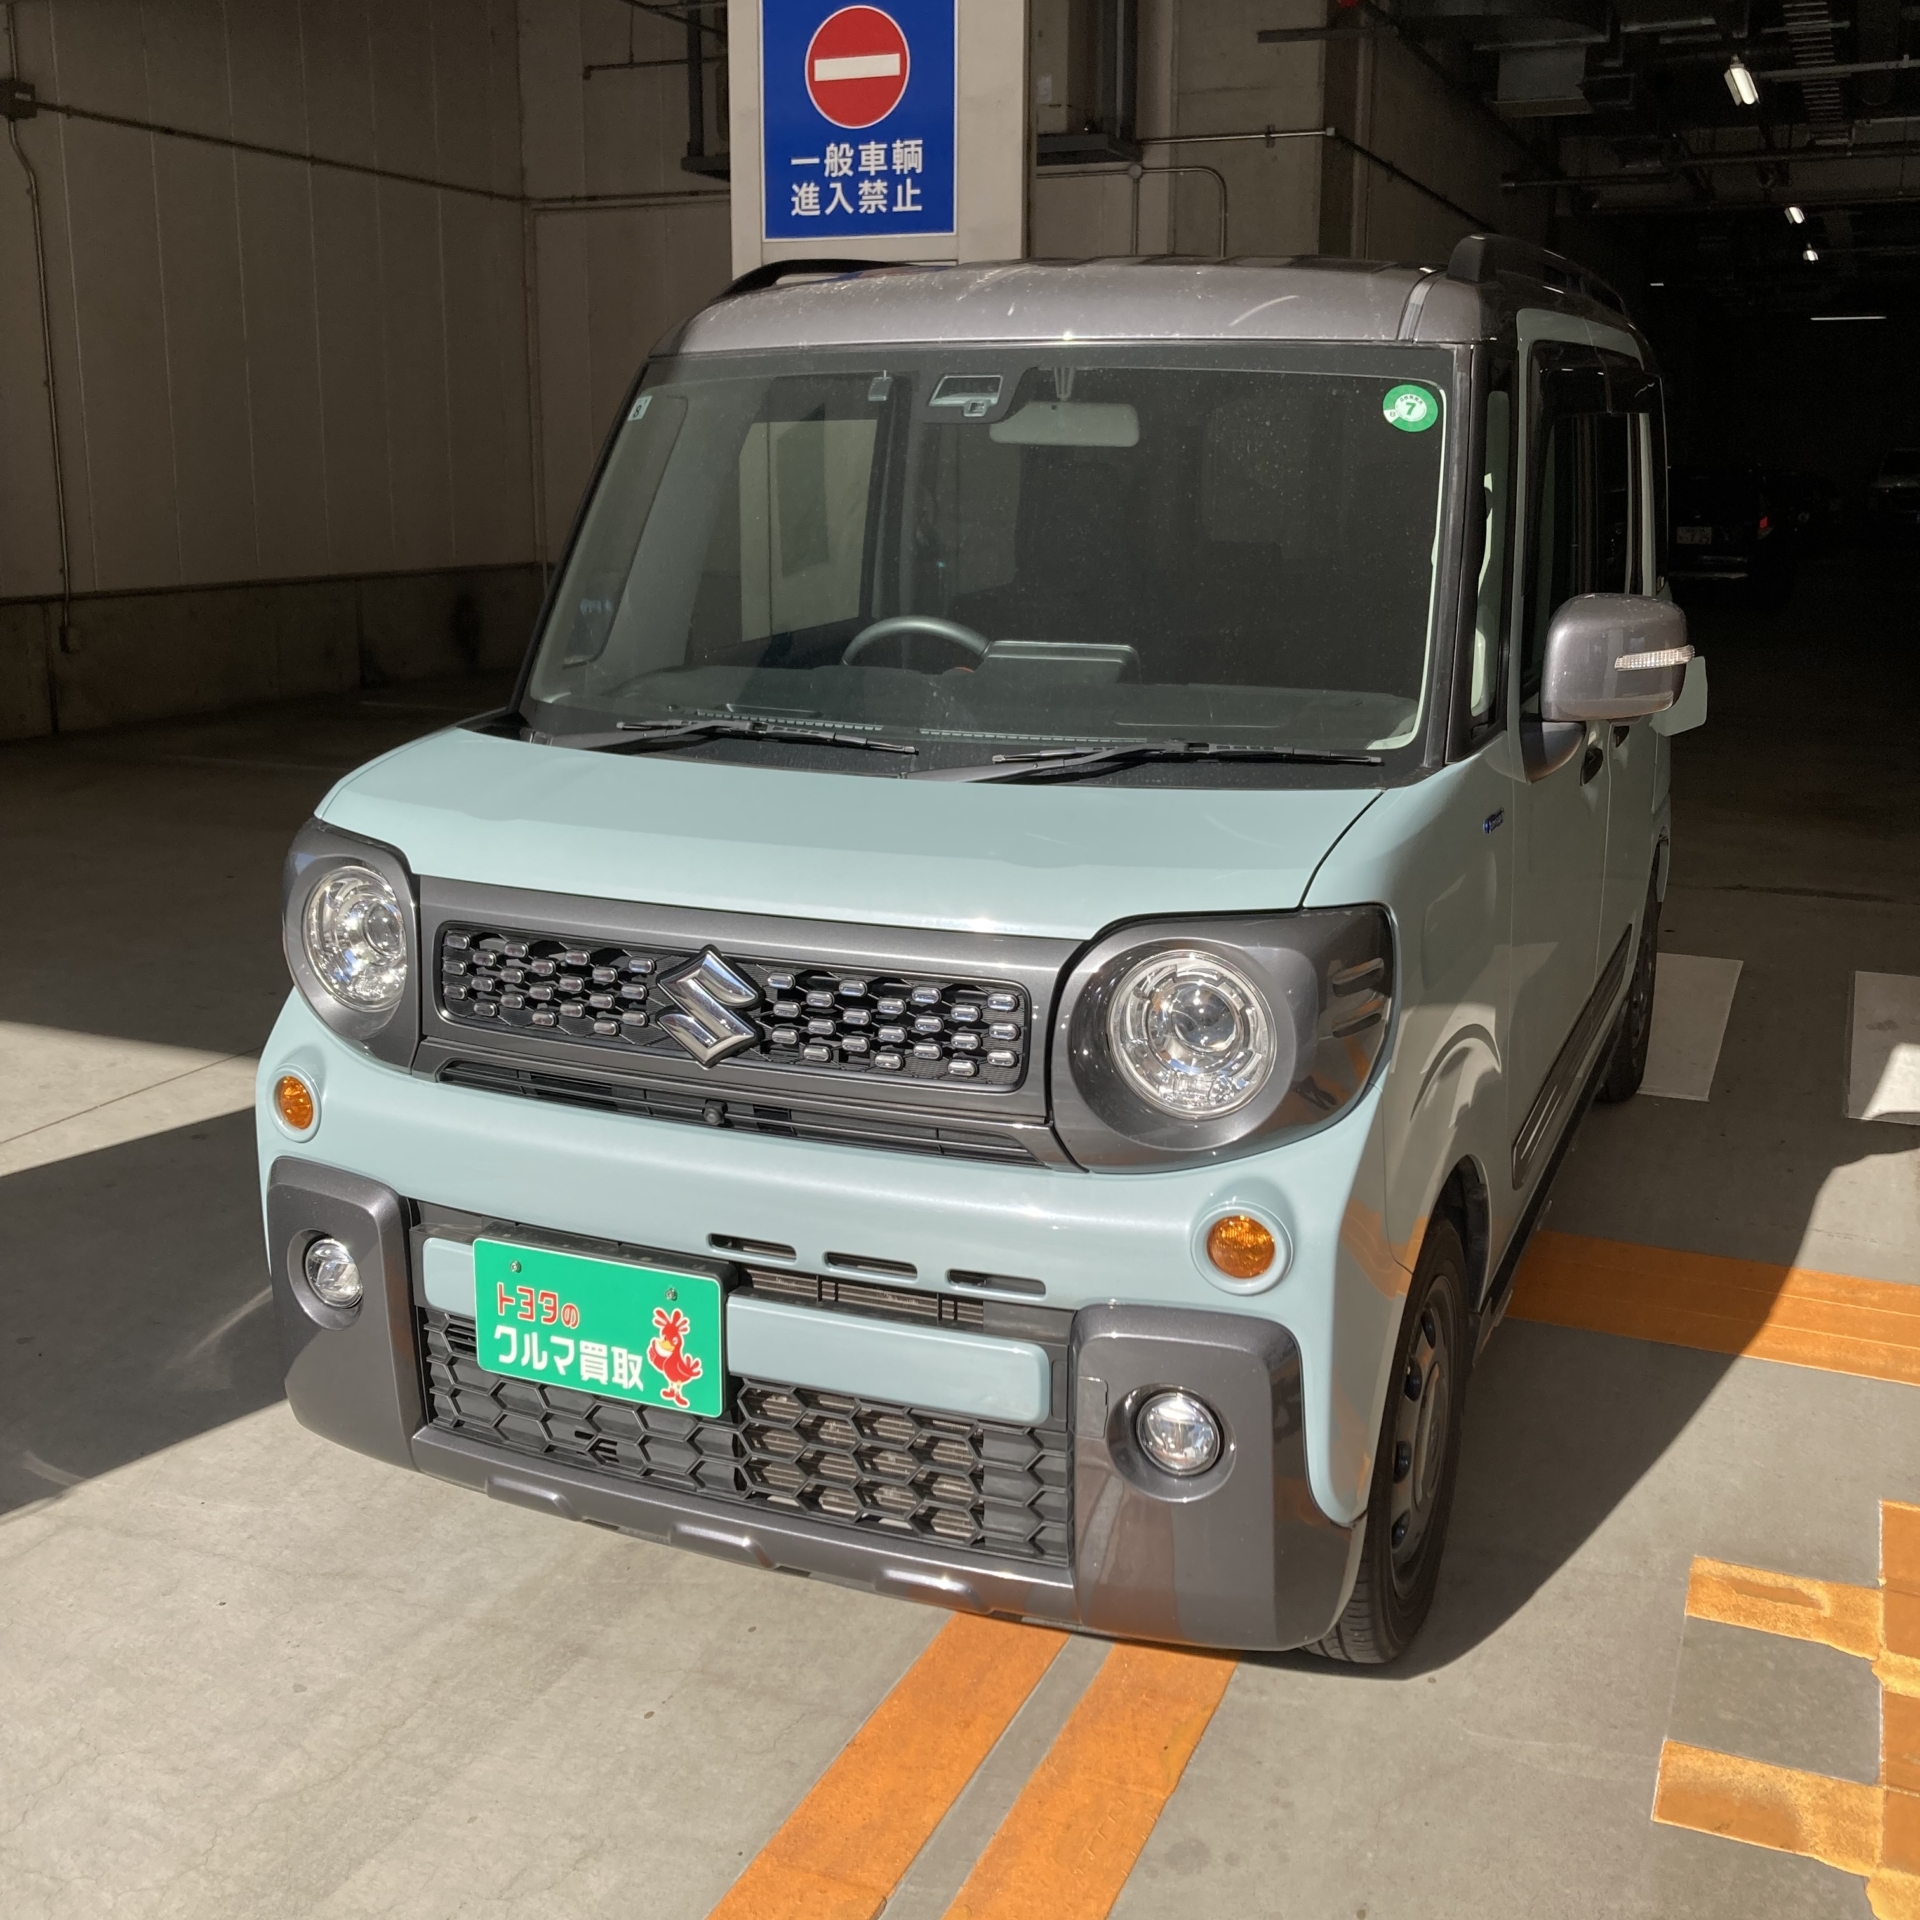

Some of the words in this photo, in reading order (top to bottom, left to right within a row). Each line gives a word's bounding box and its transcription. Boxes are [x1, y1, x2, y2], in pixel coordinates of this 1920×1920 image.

[791, 139, 923, 177] 一般車輛
[791, 178, 922, 216] 進入禁止
[633, 404, 642, 418] 8
[1405, 401, 1417, 416] 7
[497, 1282, 580, 1329] トヨタの
[494, 1324, 644, 1392] クルマ買取
